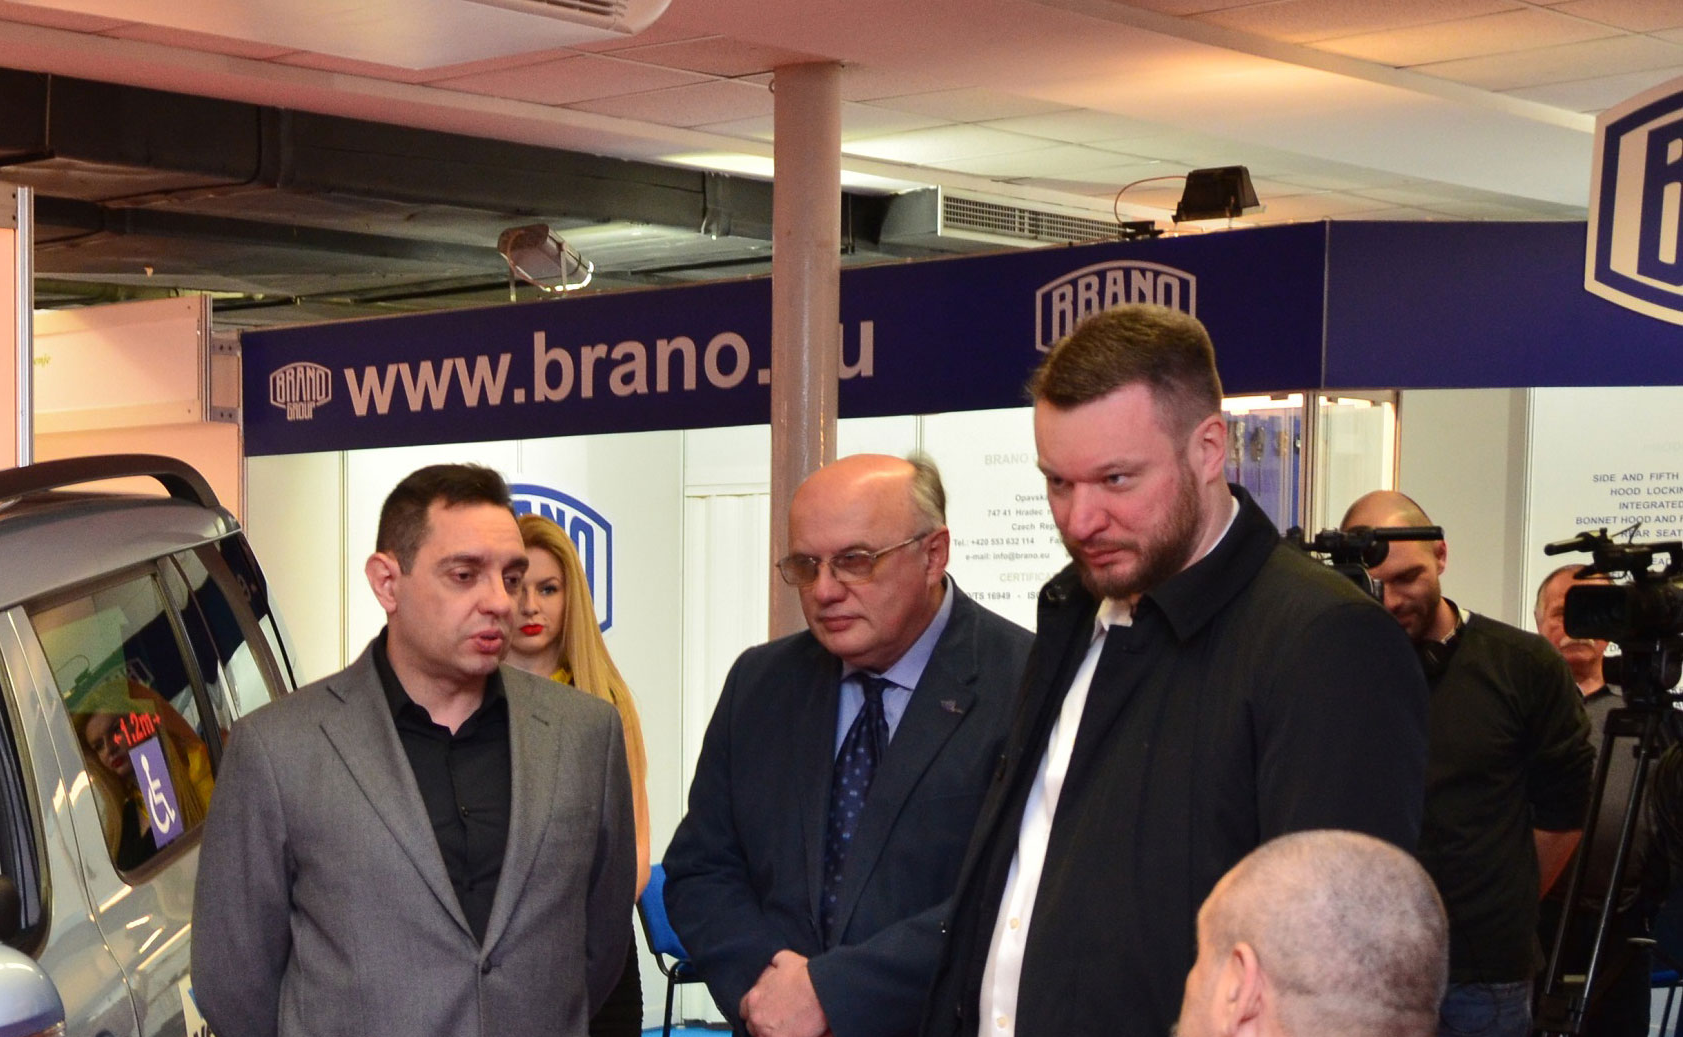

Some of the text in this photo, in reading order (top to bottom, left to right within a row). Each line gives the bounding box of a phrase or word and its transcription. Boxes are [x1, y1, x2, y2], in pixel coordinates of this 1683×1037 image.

[343, 320, 874, 417] www.brano.u
[276, 366, 327, 403] BRANO
[1593, 472, 1679, 483] SIDE AND FIFTH
[1610, 487, 1641, 495] HOOD
[1576, 516, 1618, 525] BONNET
[1621, 515, 1652, 524] HOOD
[1654, 515, 1677, 523] AND
[1011, 522, 1035, 531] Czech
[1022, 537, 1035, 545] 114
[999, 572, 1054, 583] CERTIFICA
